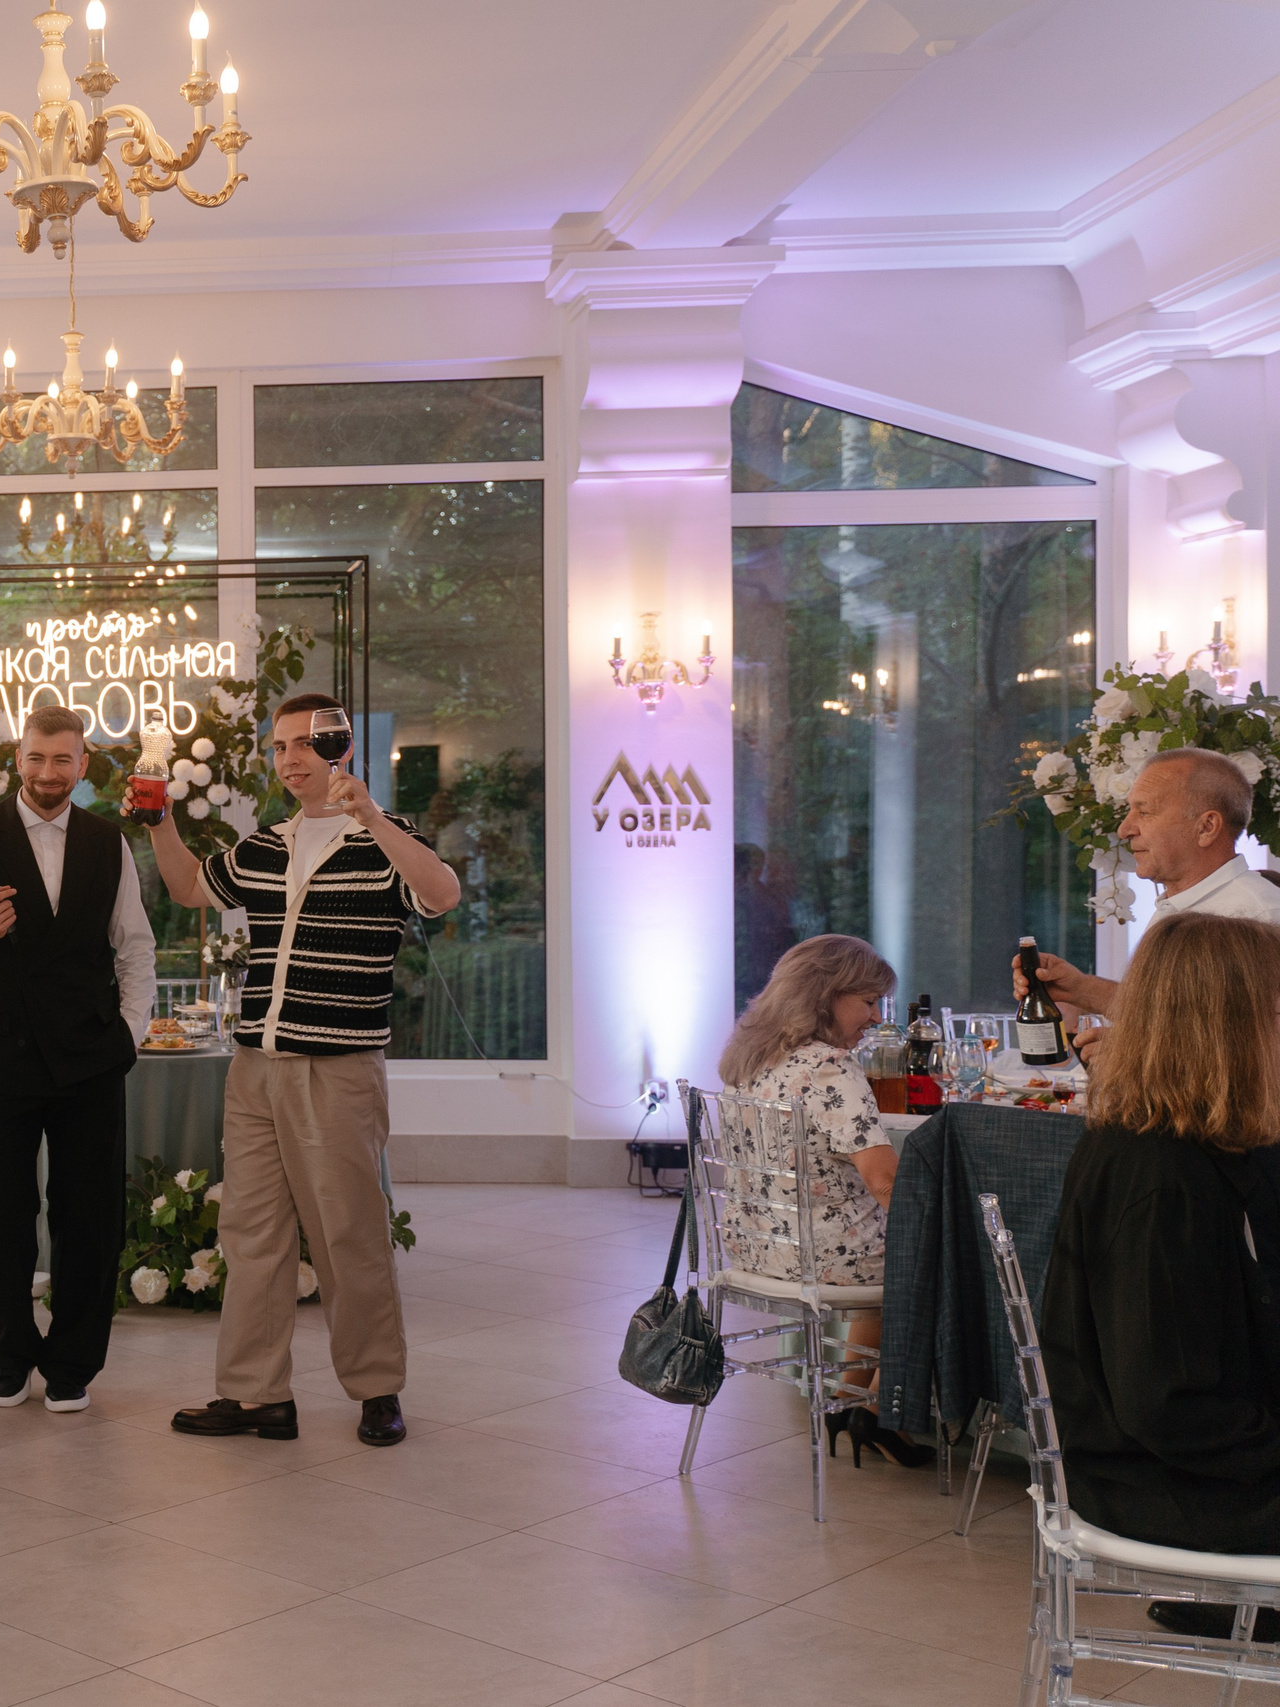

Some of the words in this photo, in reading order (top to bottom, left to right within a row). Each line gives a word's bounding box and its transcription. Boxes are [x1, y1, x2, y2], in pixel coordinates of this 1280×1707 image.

[25, 611, 154, 662] просто
[85, 641, 236, 680] сильная
[592, 807, 610, 832] У
[619, 806, 711, 832] ОЗЕРА
